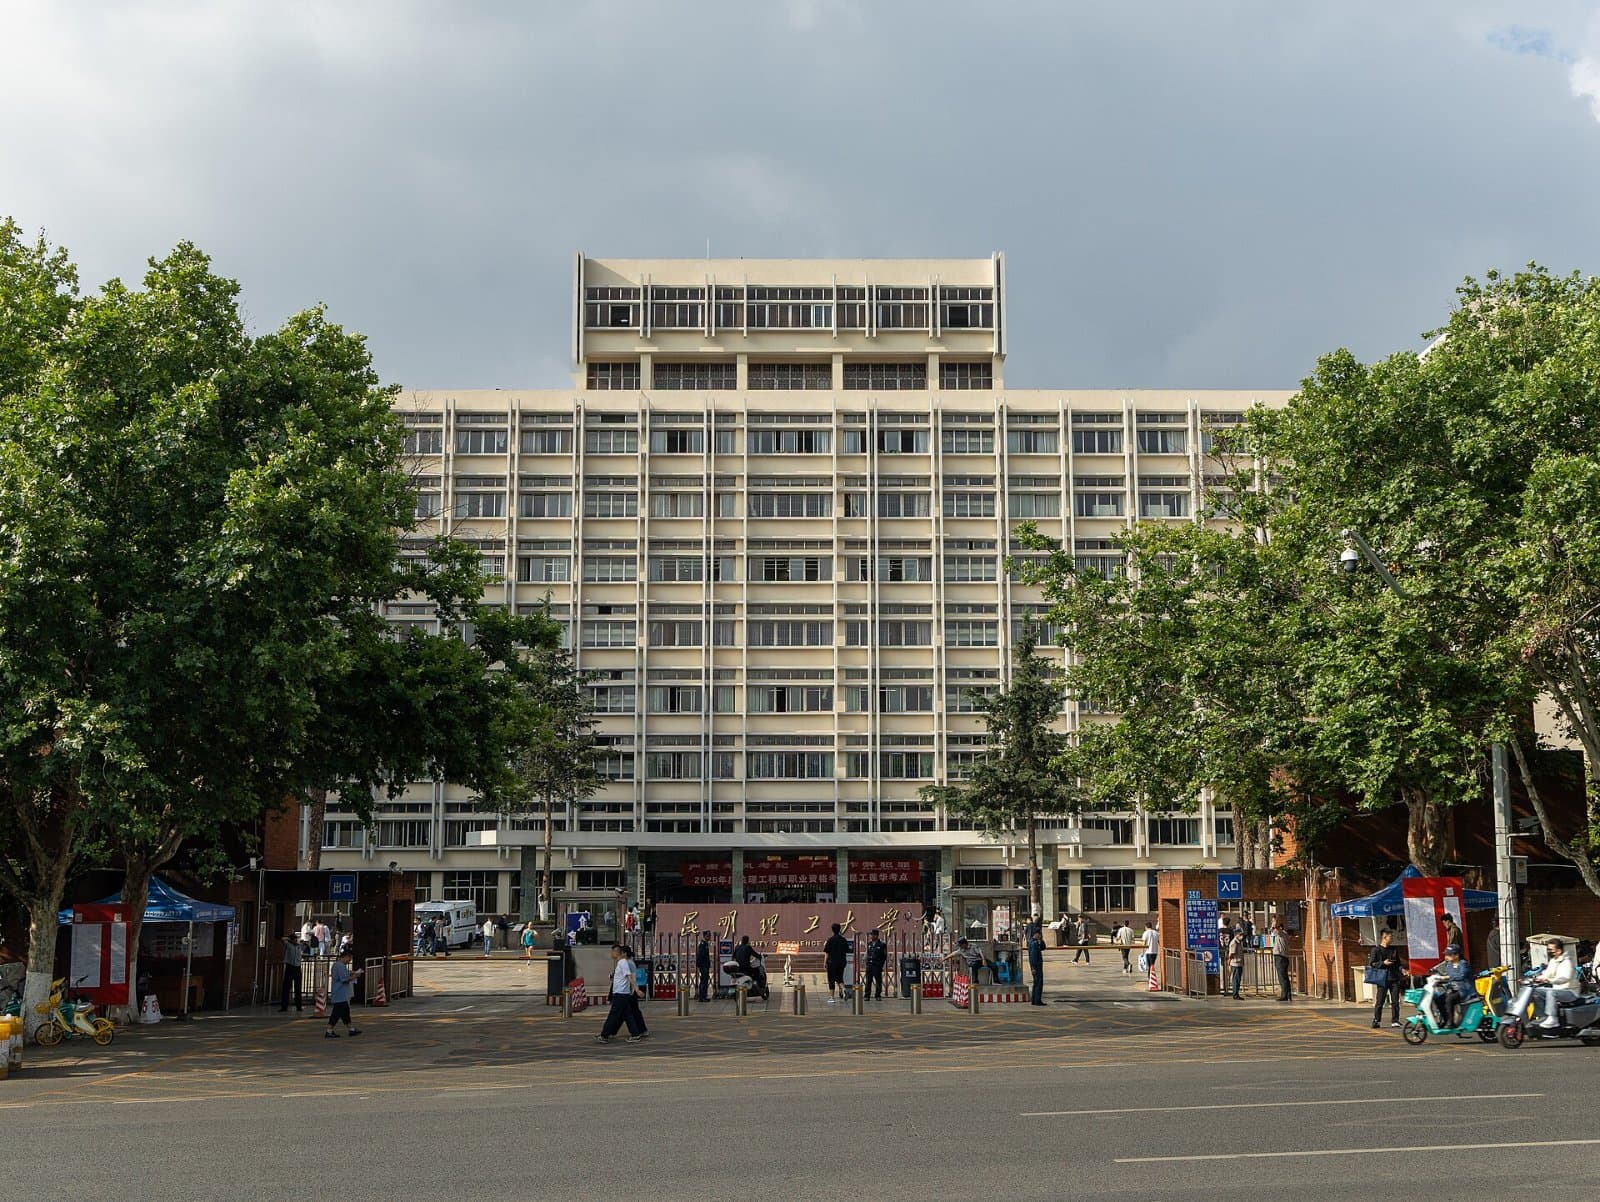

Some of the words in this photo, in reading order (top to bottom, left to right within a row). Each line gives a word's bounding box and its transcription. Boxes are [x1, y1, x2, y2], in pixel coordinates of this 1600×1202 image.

[333, 882, 352, 894] 出口
[1221, 881, 1239, 892] 入口
[681, 908, 899, 938] 昆明理工大学
